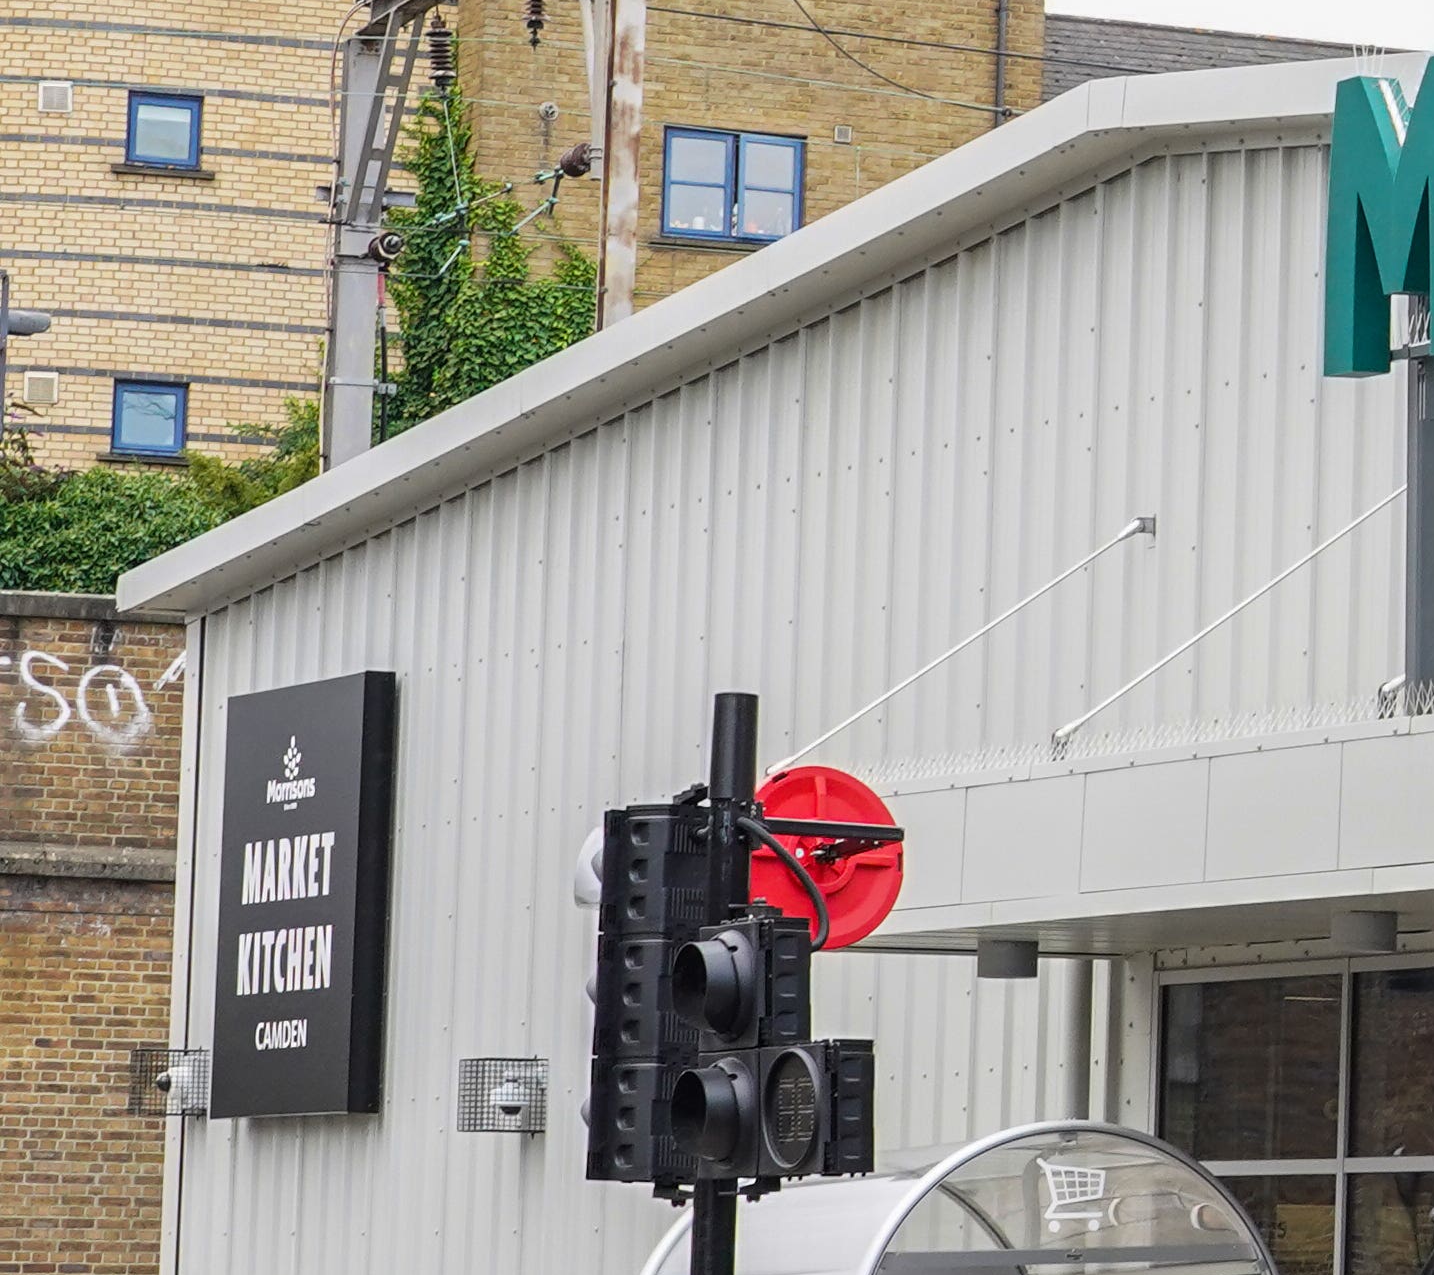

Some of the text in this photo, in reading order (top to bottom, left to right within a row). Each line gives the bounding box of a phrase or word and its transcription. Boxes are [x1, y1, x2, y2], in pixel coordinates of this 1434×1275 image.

[266, 777, 316, 804] Morrisons
[241, 831, 335, 905] MARKET
[236, 924, 333, 996] KITCHEN
[254, 1018, 308, 1051] CAMDEN
